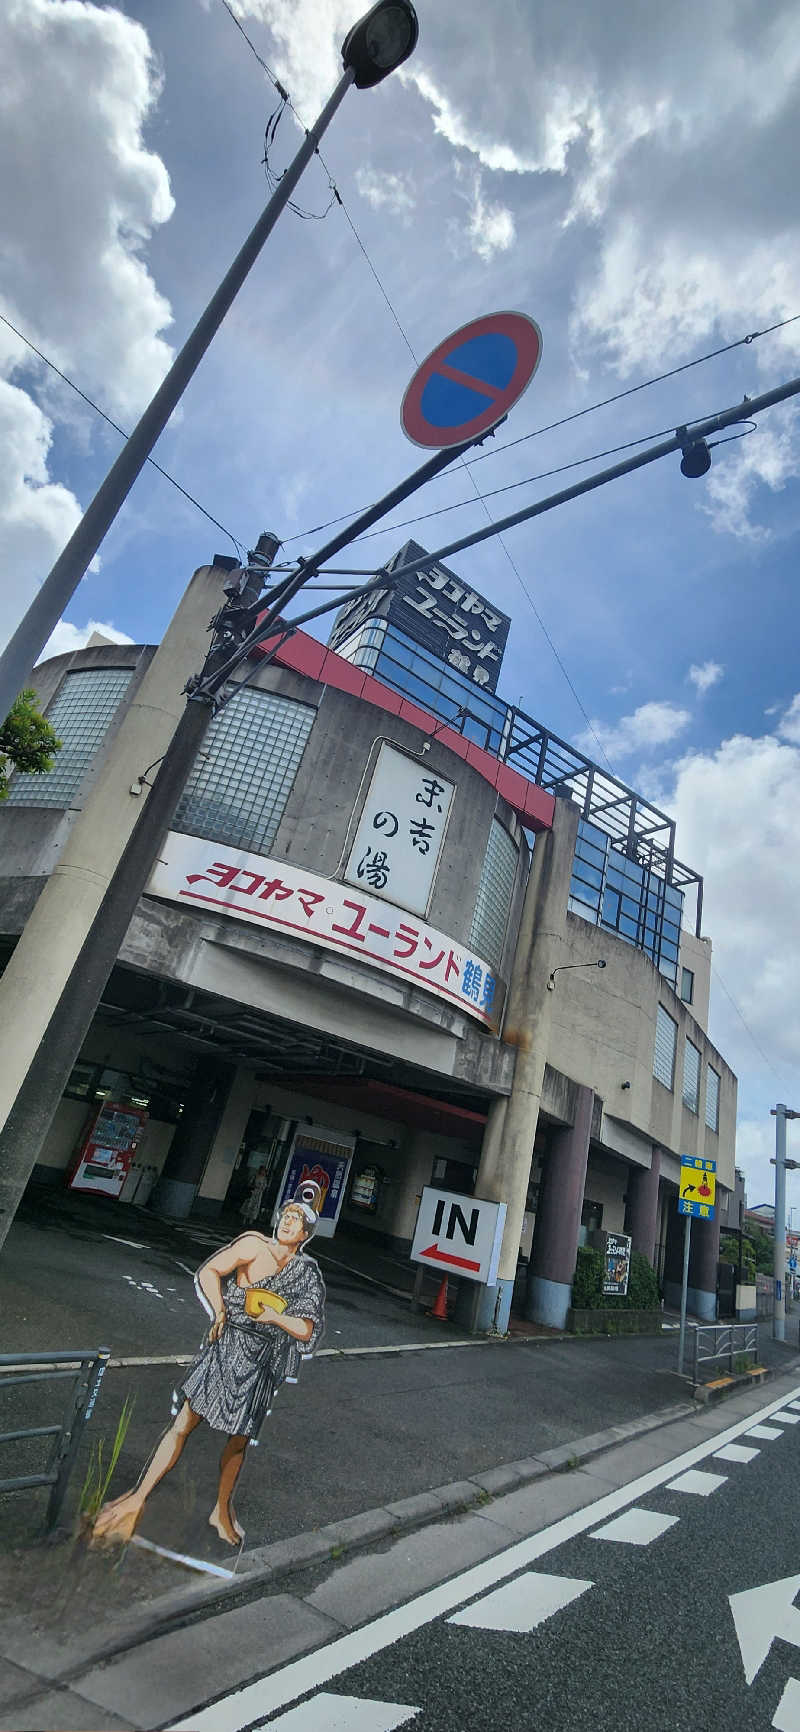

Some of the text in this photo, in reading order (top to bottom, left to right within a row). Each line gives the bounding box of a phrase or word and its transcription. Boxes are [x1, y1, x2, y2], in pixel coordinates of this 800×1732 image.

[402, 586, 502, 662] ユーランド
[416, 566, 502, 633] ヨコヤマ
[357, 811, 399, 889] の湯
[185, 862, 496, 1012] ヨコヤマ ユーランド 鶴見
[432, 1199, 480, 1246] IN
[682, 1201, 710, 1217] 注意
